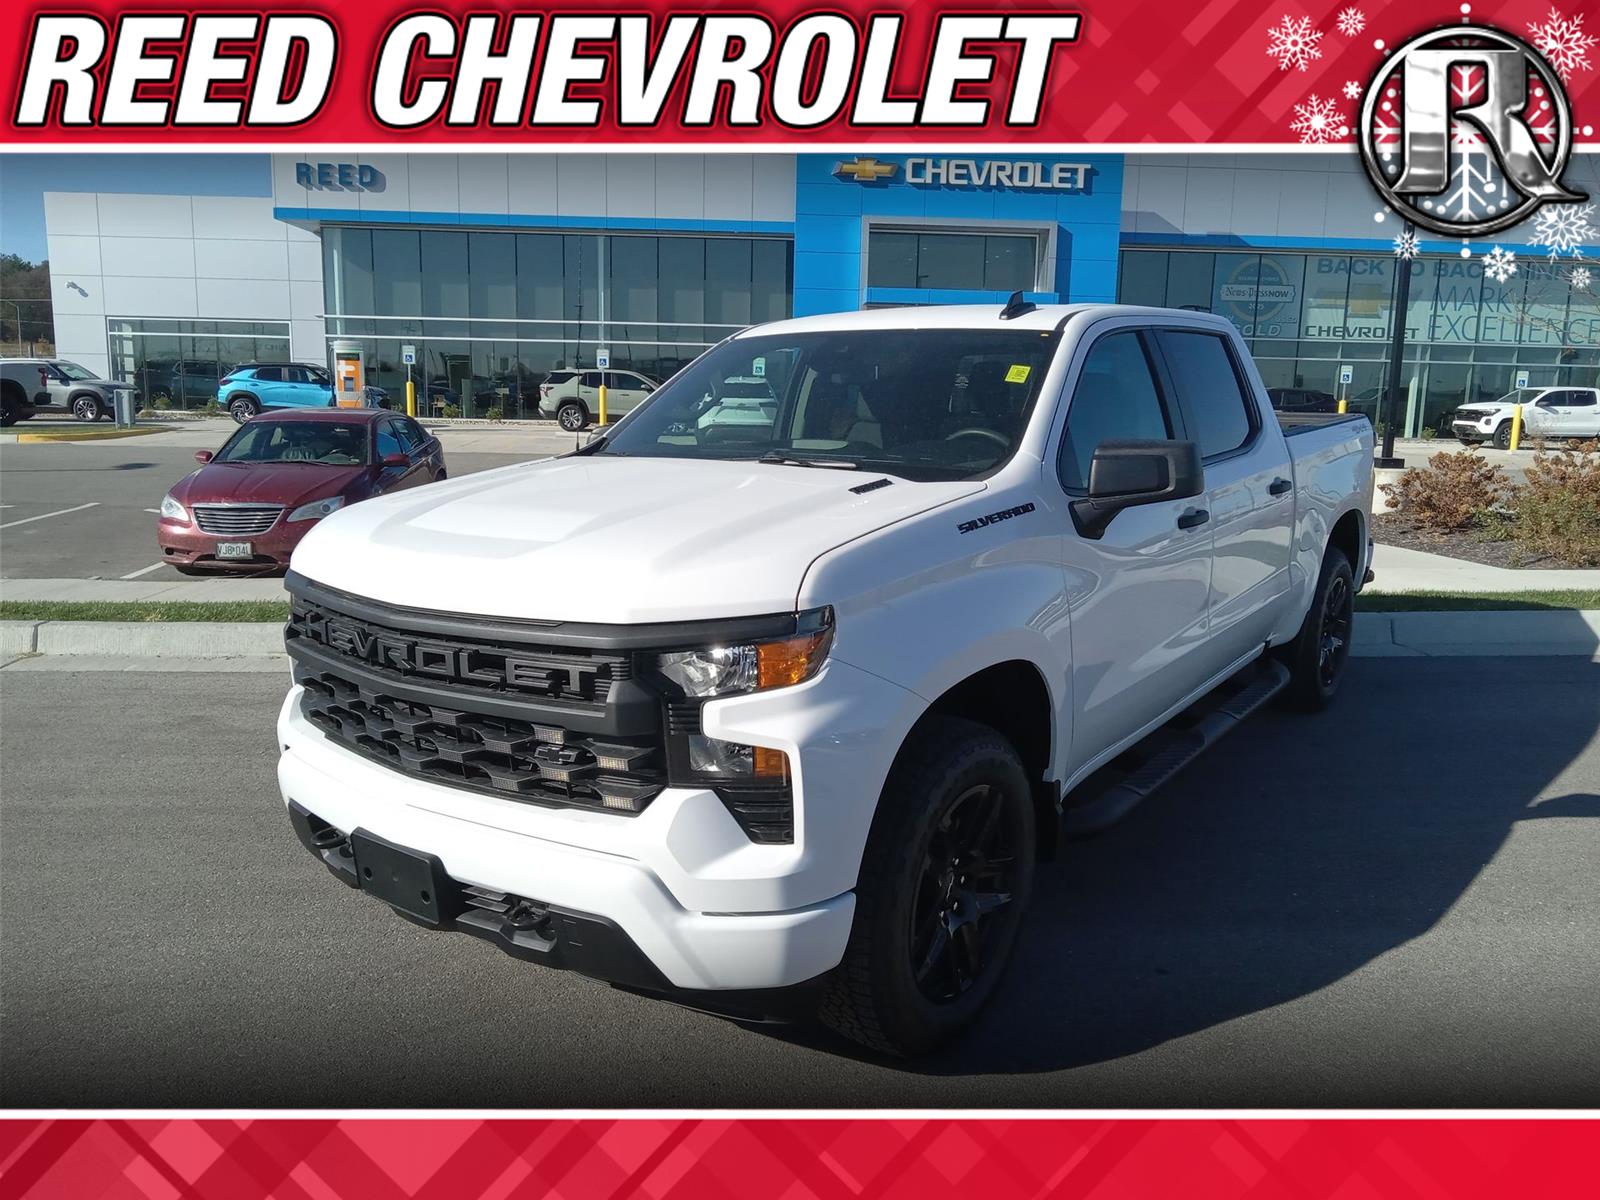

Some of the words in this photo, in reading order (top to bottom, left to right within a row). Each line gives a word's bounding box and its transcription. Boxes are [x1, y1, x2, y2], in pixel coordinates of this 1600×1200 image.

[296, 162, 376, 188] REED
[905, 158, 1091, 189] CHEVROLET
[1317, 258, 1385, 275] BACK
[1432, 262, 1492, 279] BAC
[1429, 285, 1513, 313] MARK
[1305, 326, 1419, 339] CHEVROT
[1427, 314, 1600, 344] EXCELLENCE
[957, 502, 1036, 535] SILVERADO
